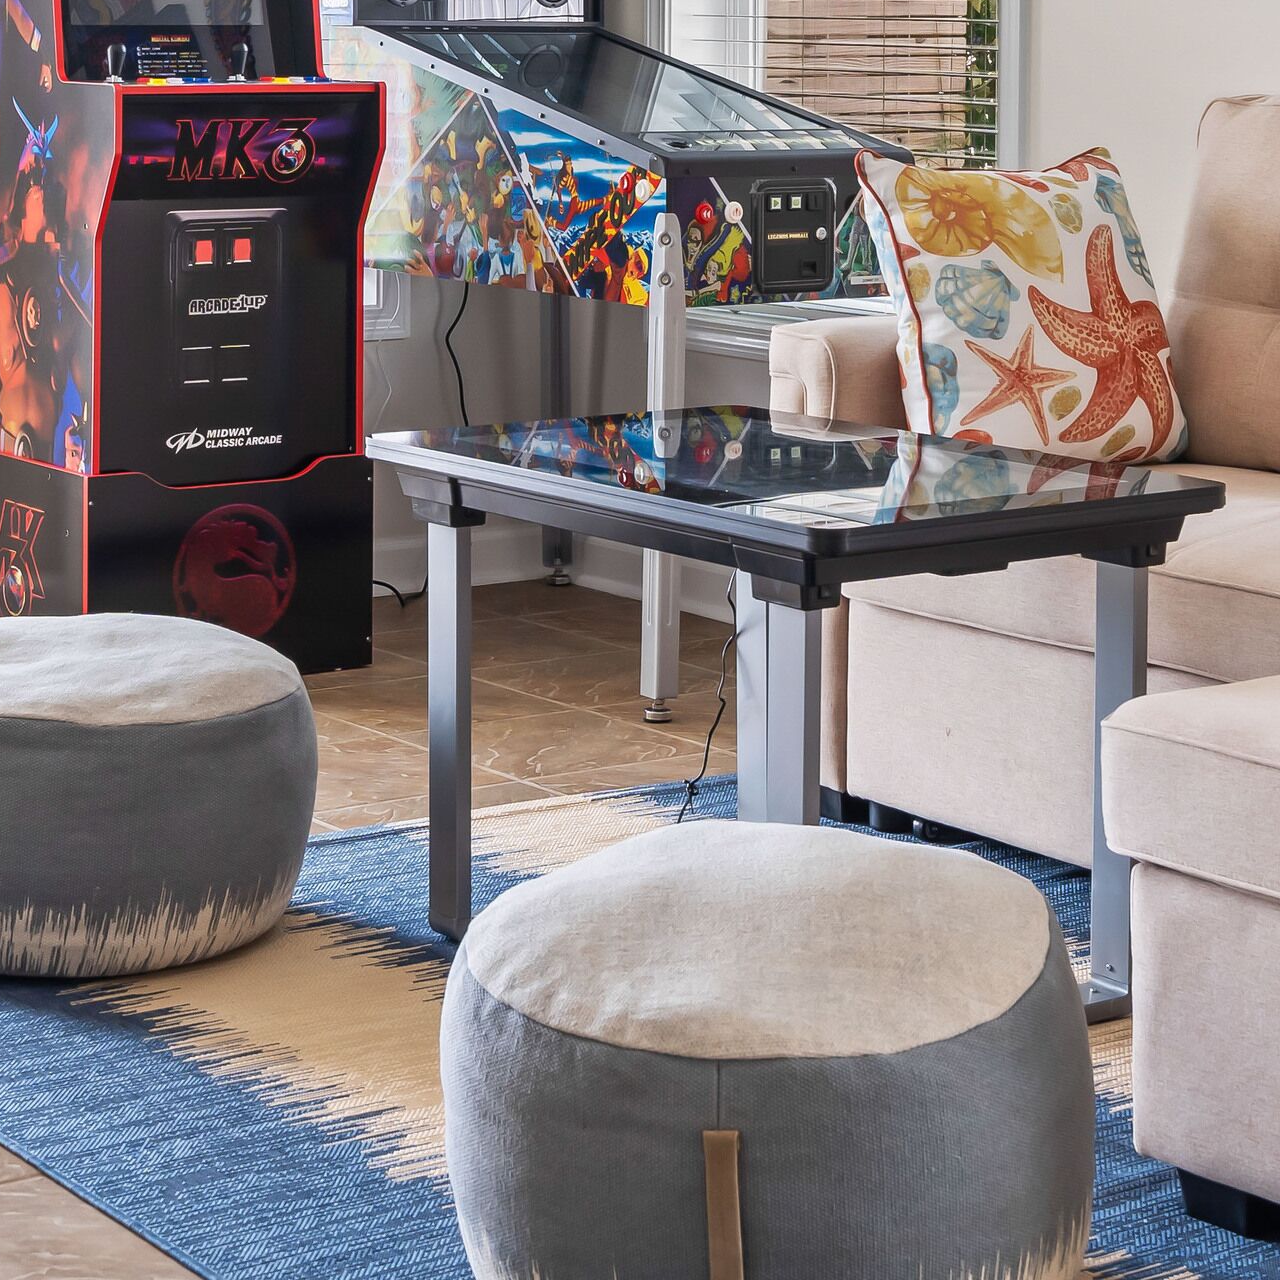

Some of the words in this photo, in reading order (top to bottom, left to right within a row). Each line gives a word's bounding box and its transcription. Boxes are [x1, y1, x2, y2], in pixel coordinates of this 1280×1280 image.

[206, 427, 253, 439] MIDWAY
[205, 437, 245, 449] CLASSIC
[245, 435, 283, 448] ARCADE
